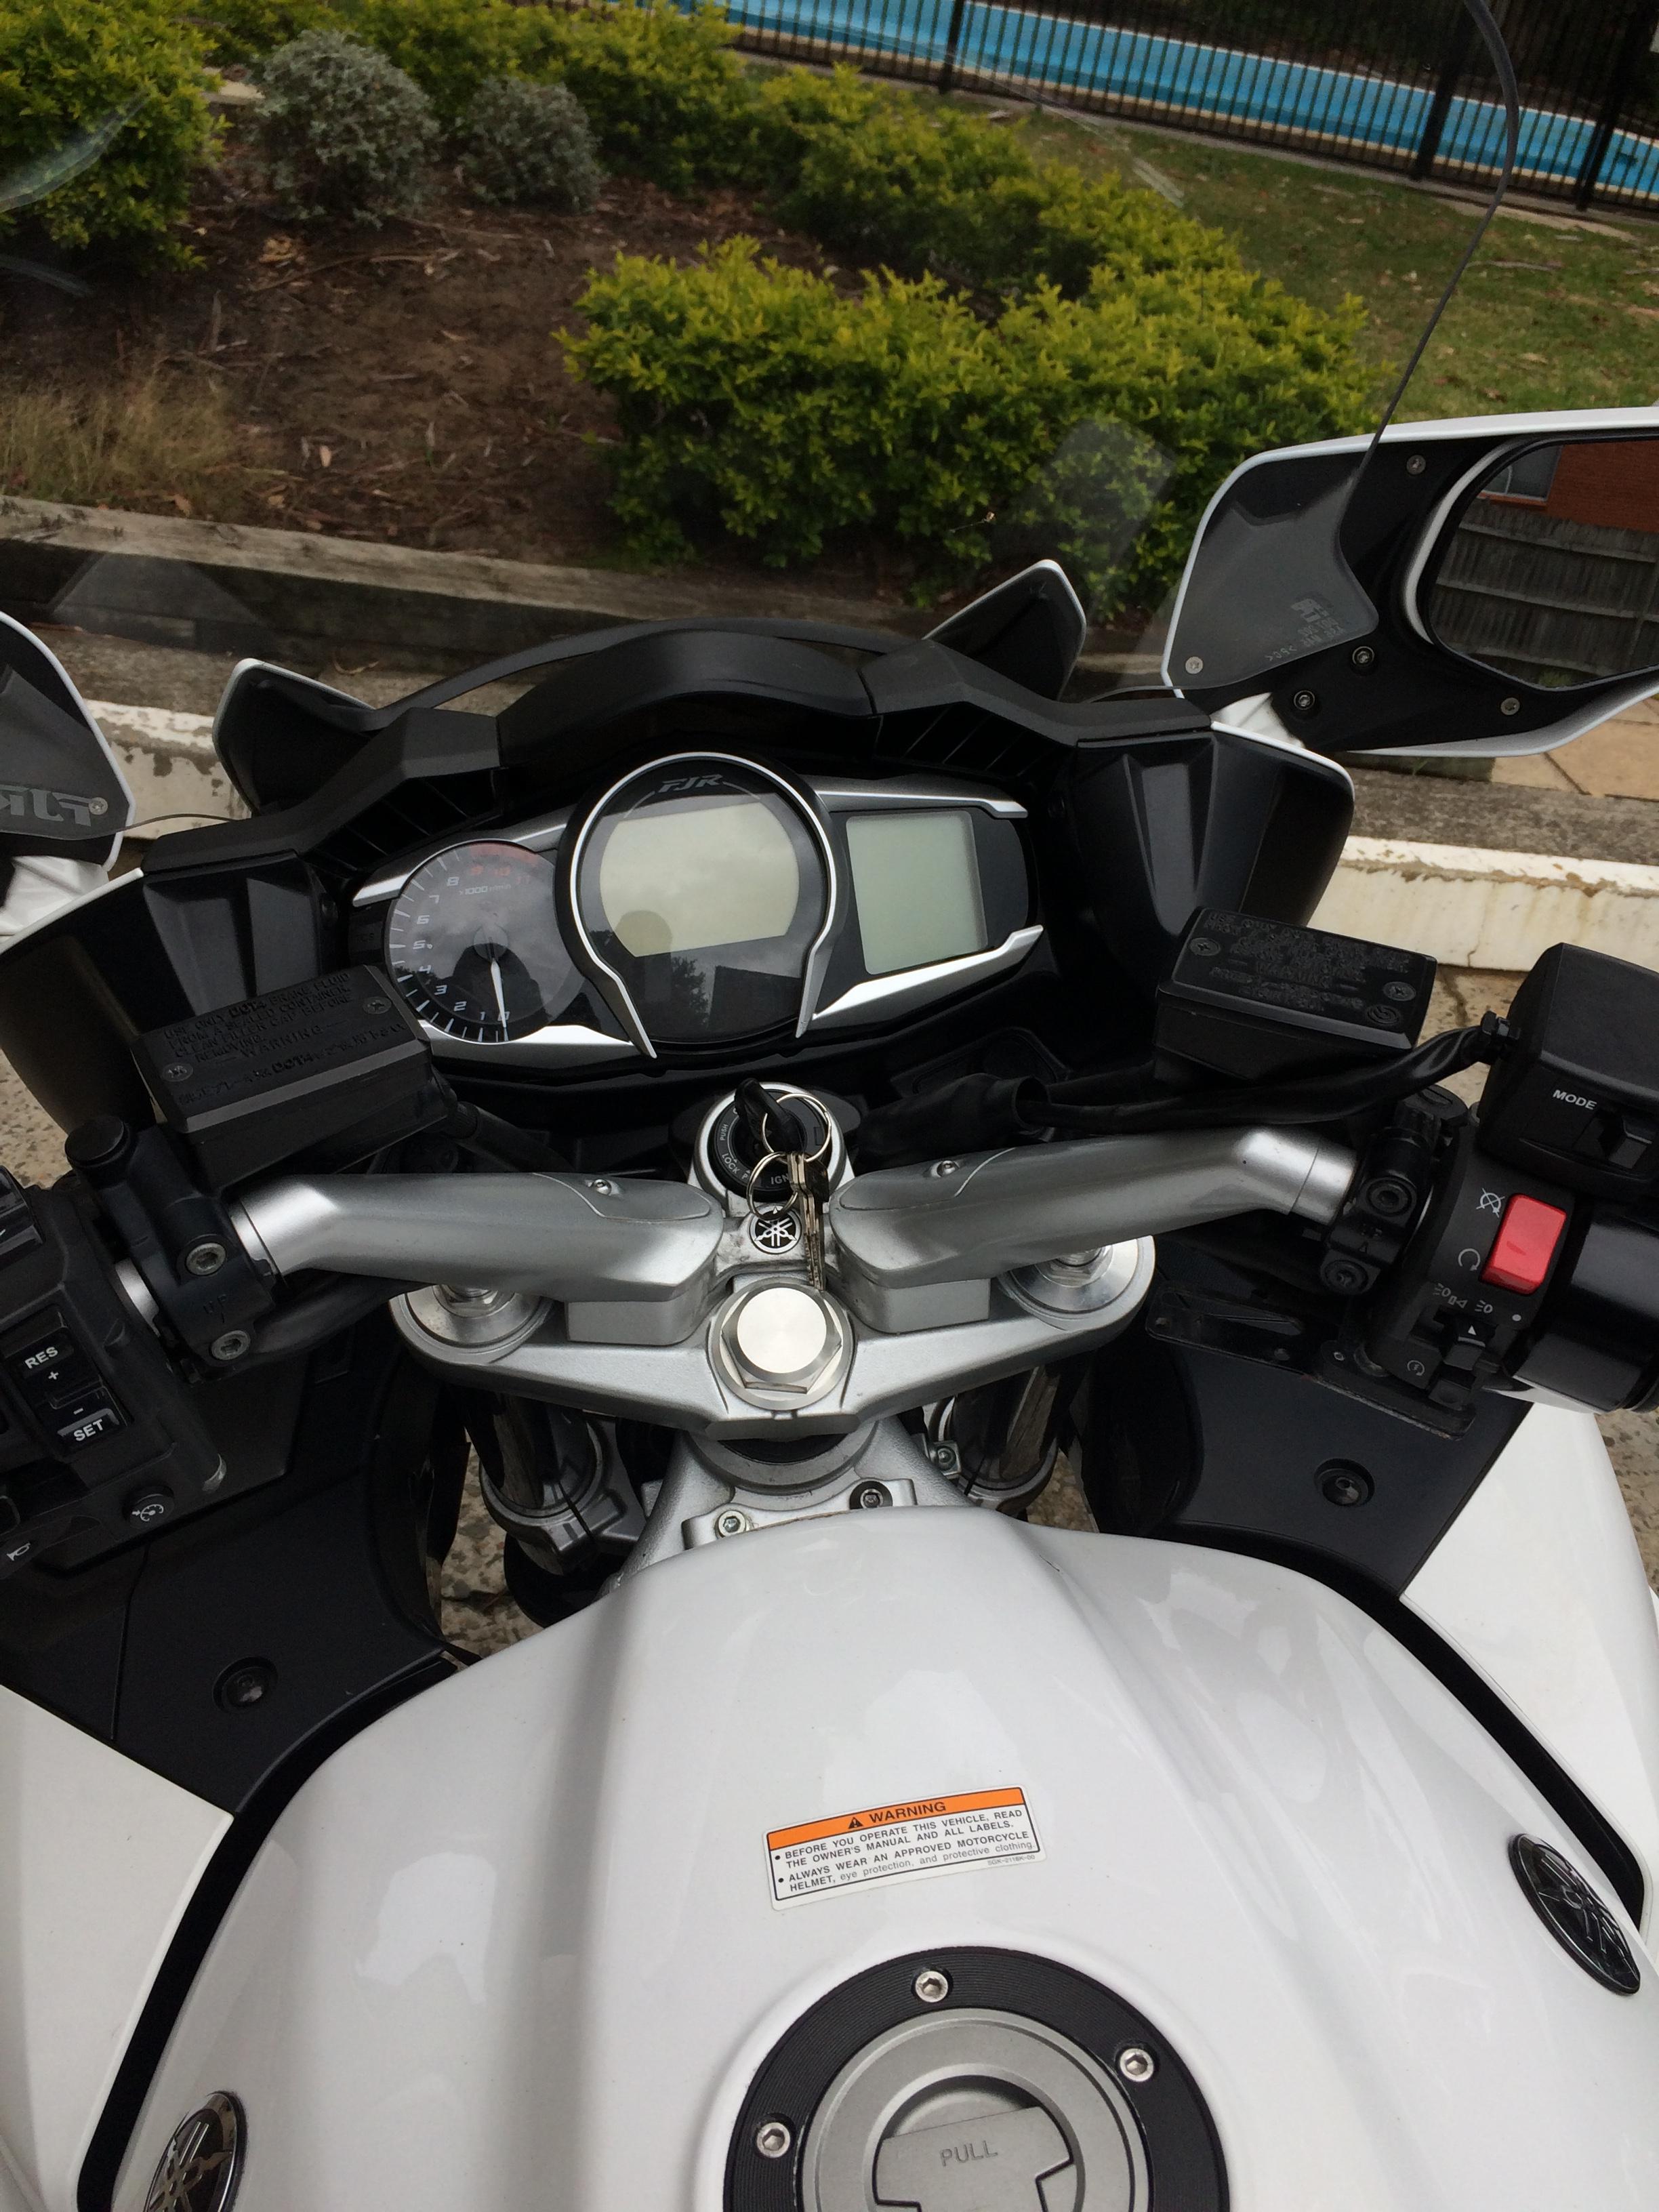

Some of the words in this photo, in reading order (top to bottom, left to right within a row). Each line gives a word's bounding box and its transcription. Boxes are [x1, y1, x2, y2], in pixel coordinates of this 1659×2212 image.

[657, 774, 723, 793] FJR
[445, 876, 460, 887] 8
[429, 895, 441, 905] 7
[415, 914, 431, 925] 6
[418, 964, 432, 974] 4
[314, 972, 351, 991] FLUID
[434, 984, 449, 996] 3
[453, 1000, 468, 1012] 2
[479, 1010, 487, 1021] 1
[1552, 1088, 1598, 1111] MODE
[718, 1123, 729, 1142] PUSH
[721, 1152, 741, 1174] LOCK
[24, 1345, 59, 1370] RES
[73, 1418, 104, 1441] SET
[868, 1801, 947, 1824] WARNING
[785, 1843, 827, 1859] BEFORE
[832, 1837, 855, 1847] YOU
[859, 1826, 908, 1842] OPERATE
[913, 1822, 937, 1832] THIS
[941, 1814, 989, 1826] VEHICLE,
[994, 1809, 1023, 1820] READ
[786, 1857, 807, 1869] THE
[813, 1845, 861, 1862] OWNER'S
[866, 1836, 911, 1851] MANUAL
[917, 1831, 939, 1841] AND
[944, 1827, 964, 1837] ALL
[969, 1820, 1014, 1833] LABELS.
[789, 1866, 830, 1882] ALWAYS
[835, 1857, 868, 1870] WEAR
[873, 1853, 888, 1864] AN
[895, 1842, 951, 1859] APPROVED
[957, 1830, 1029, 1848] MOTORCYCLE
[790, 1875, 836, 1892] HELMET,
[840, 1870, 857, 1881] eye
[919, 1854, 937, 1865] and
[943, 1847, 990, 1862] protective
[995, 1841, 1036, 1853] clothing.
[939, 2139, 999, 2167] PULL
